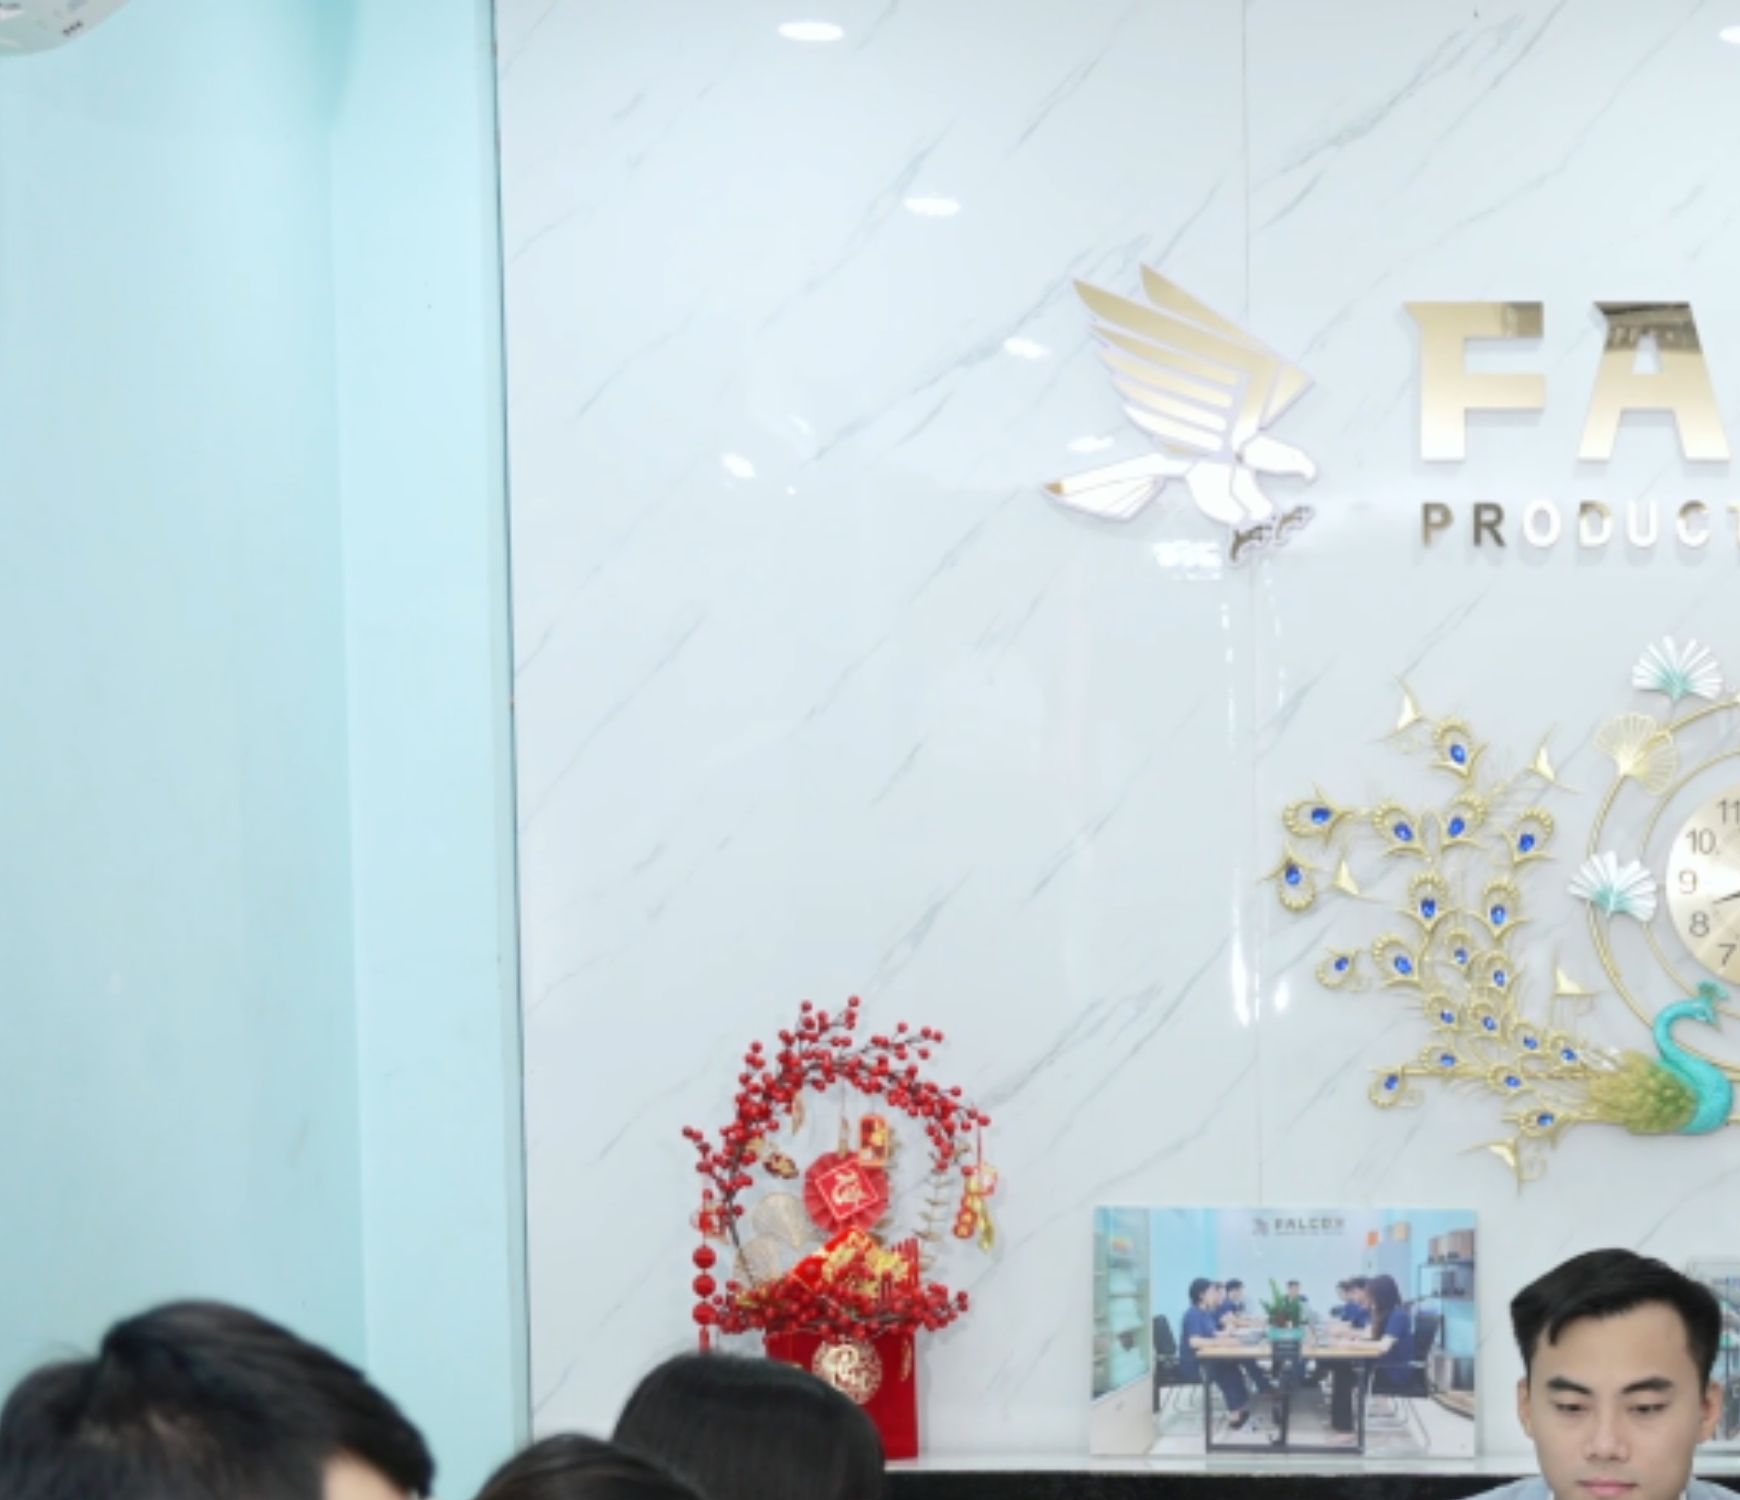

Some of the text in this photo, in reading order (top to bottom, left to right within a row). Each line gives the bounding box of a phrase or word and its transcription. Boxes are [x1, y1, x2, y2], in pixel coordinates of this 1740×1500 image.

[1686, 828, 1716, 855] 10
[1678, 870, 1697, 895] 9
[1689, 911, 1710, 937] 8
[1718, 944, 1737, 966] 7
[1274, 1217, 1345, 1231] FALCON
